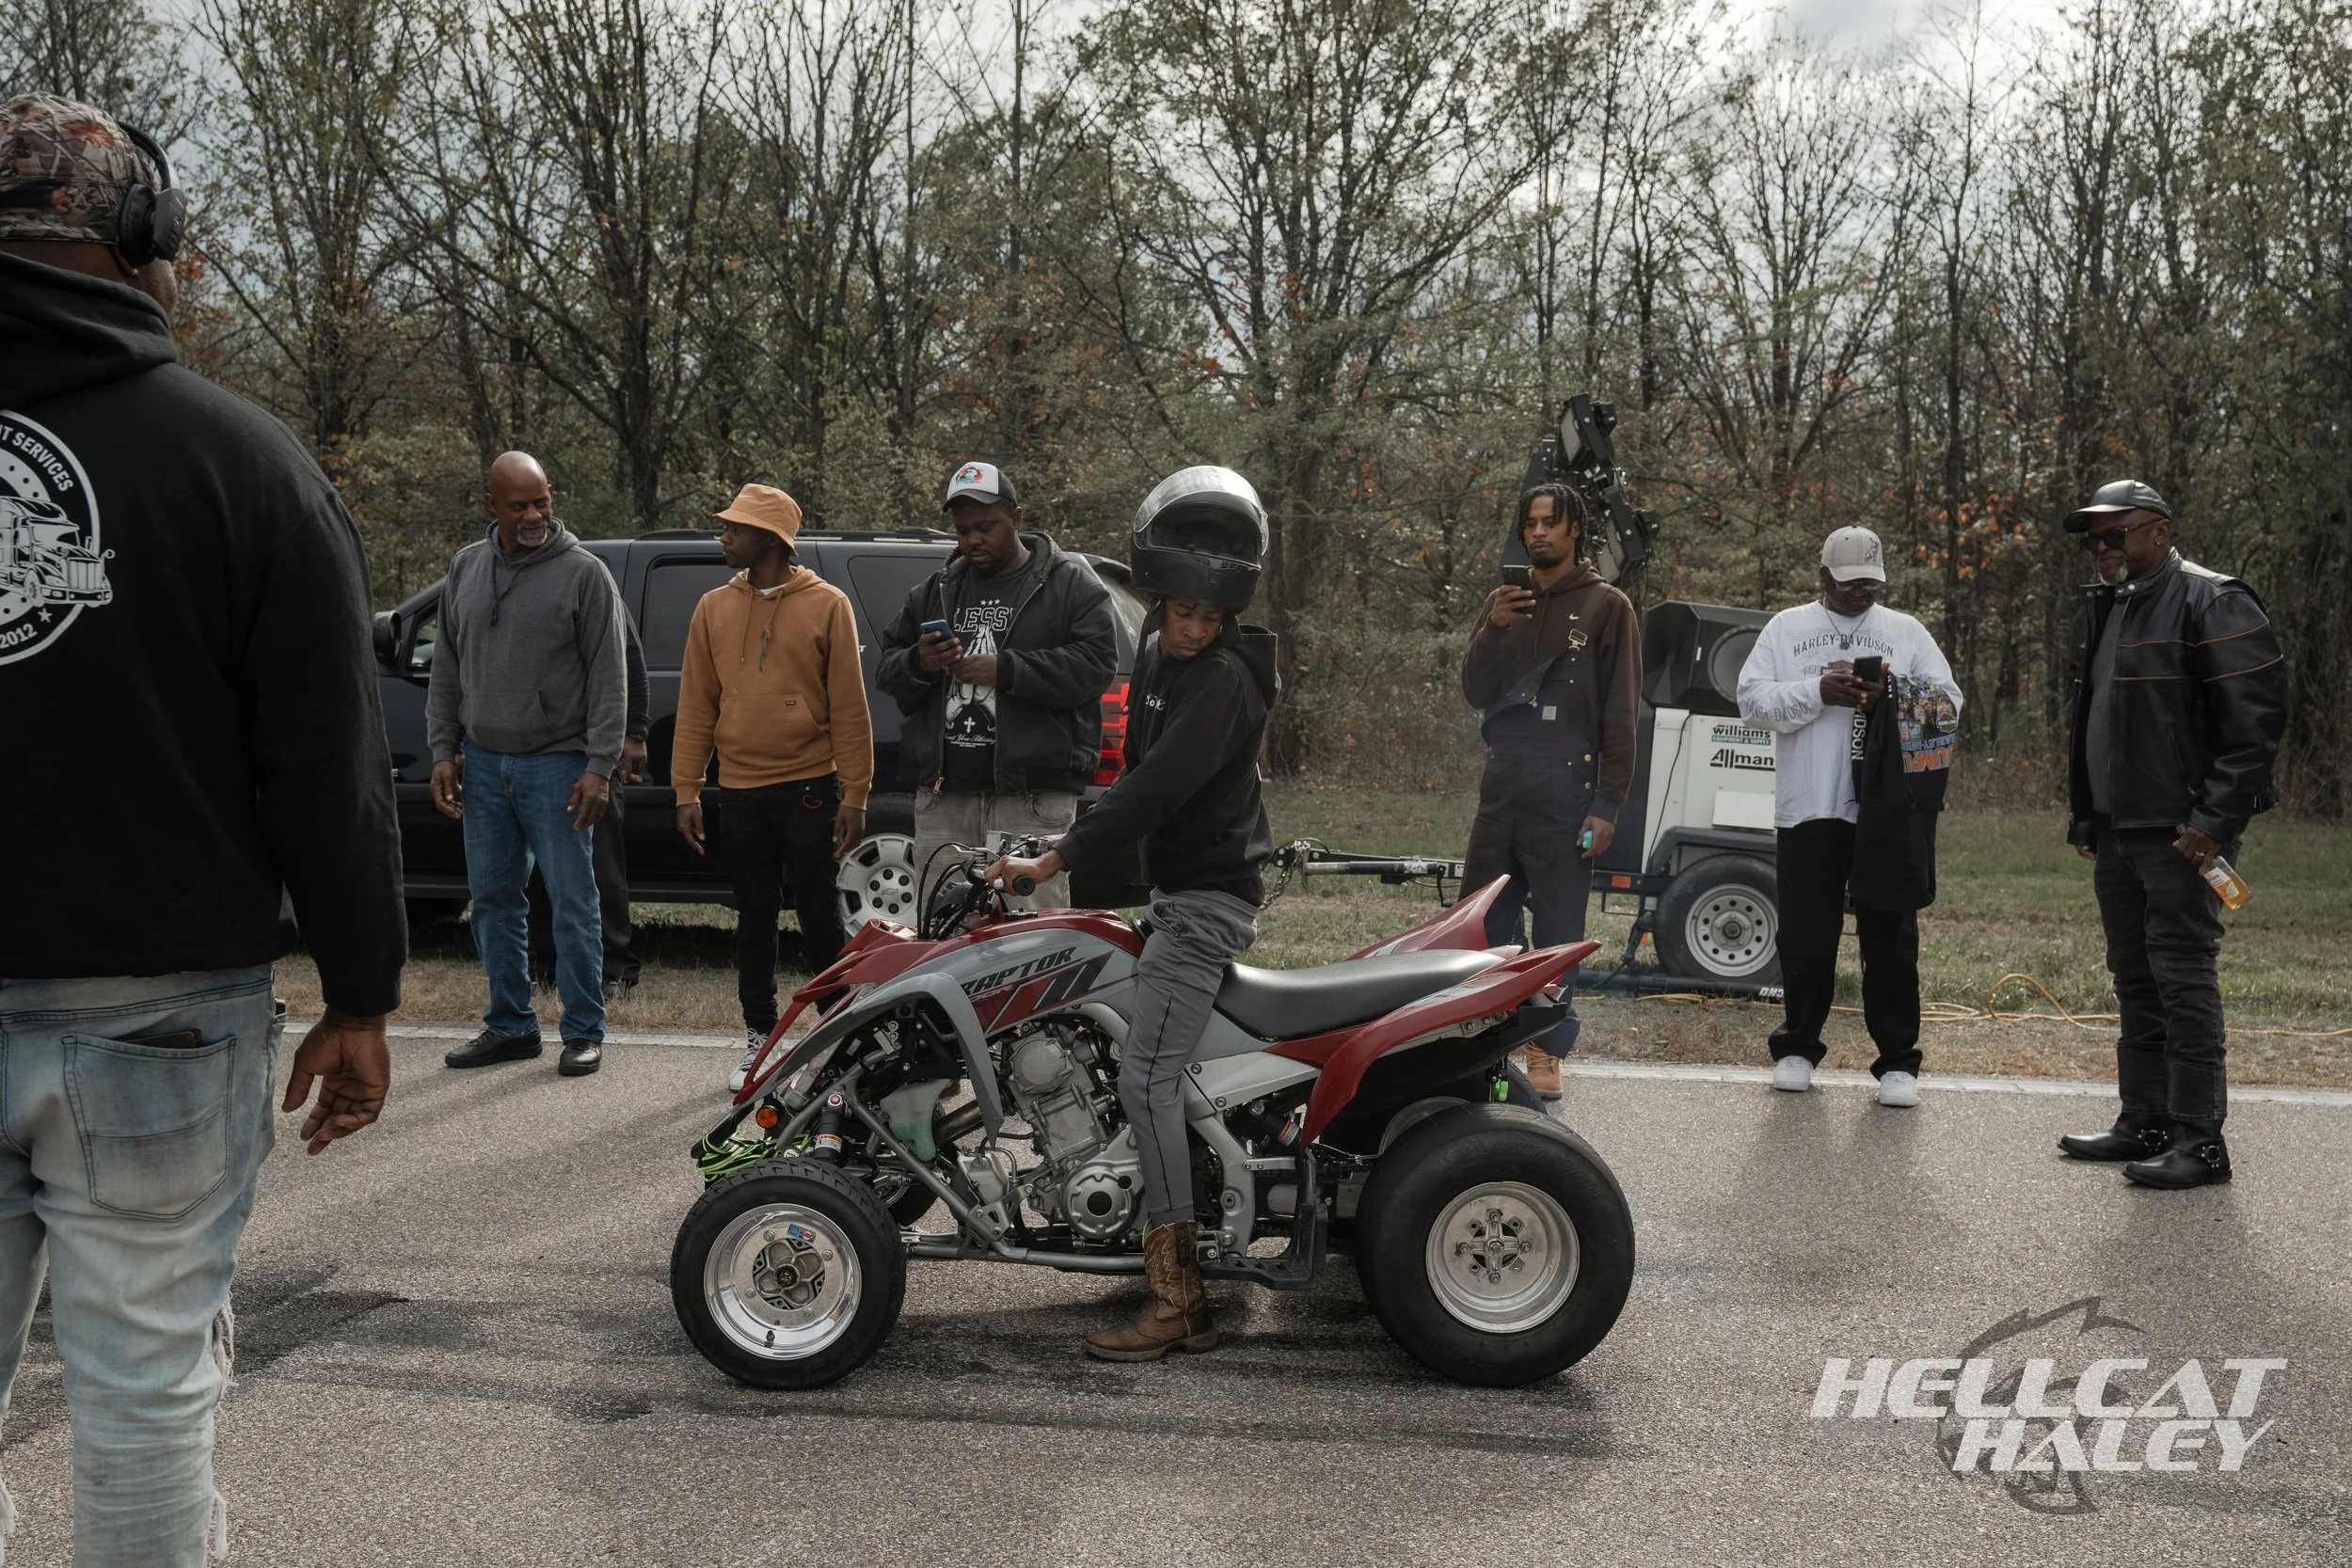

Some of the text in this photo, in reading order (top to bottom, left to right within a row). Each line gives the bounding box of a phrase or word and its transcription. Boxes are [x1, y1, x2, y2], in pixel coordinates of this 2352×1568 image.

[12, 432, 73, 492] SERVICES
[0, 623, 39, 649] 2012
[1793, 633, 1894, 658] HARLEY-DAVIDSON
[1712, 724, 1771, 738] williams
[1710, 749, 1775, 769] Allman
[960, 946, 1078, 996] RAPTOR
